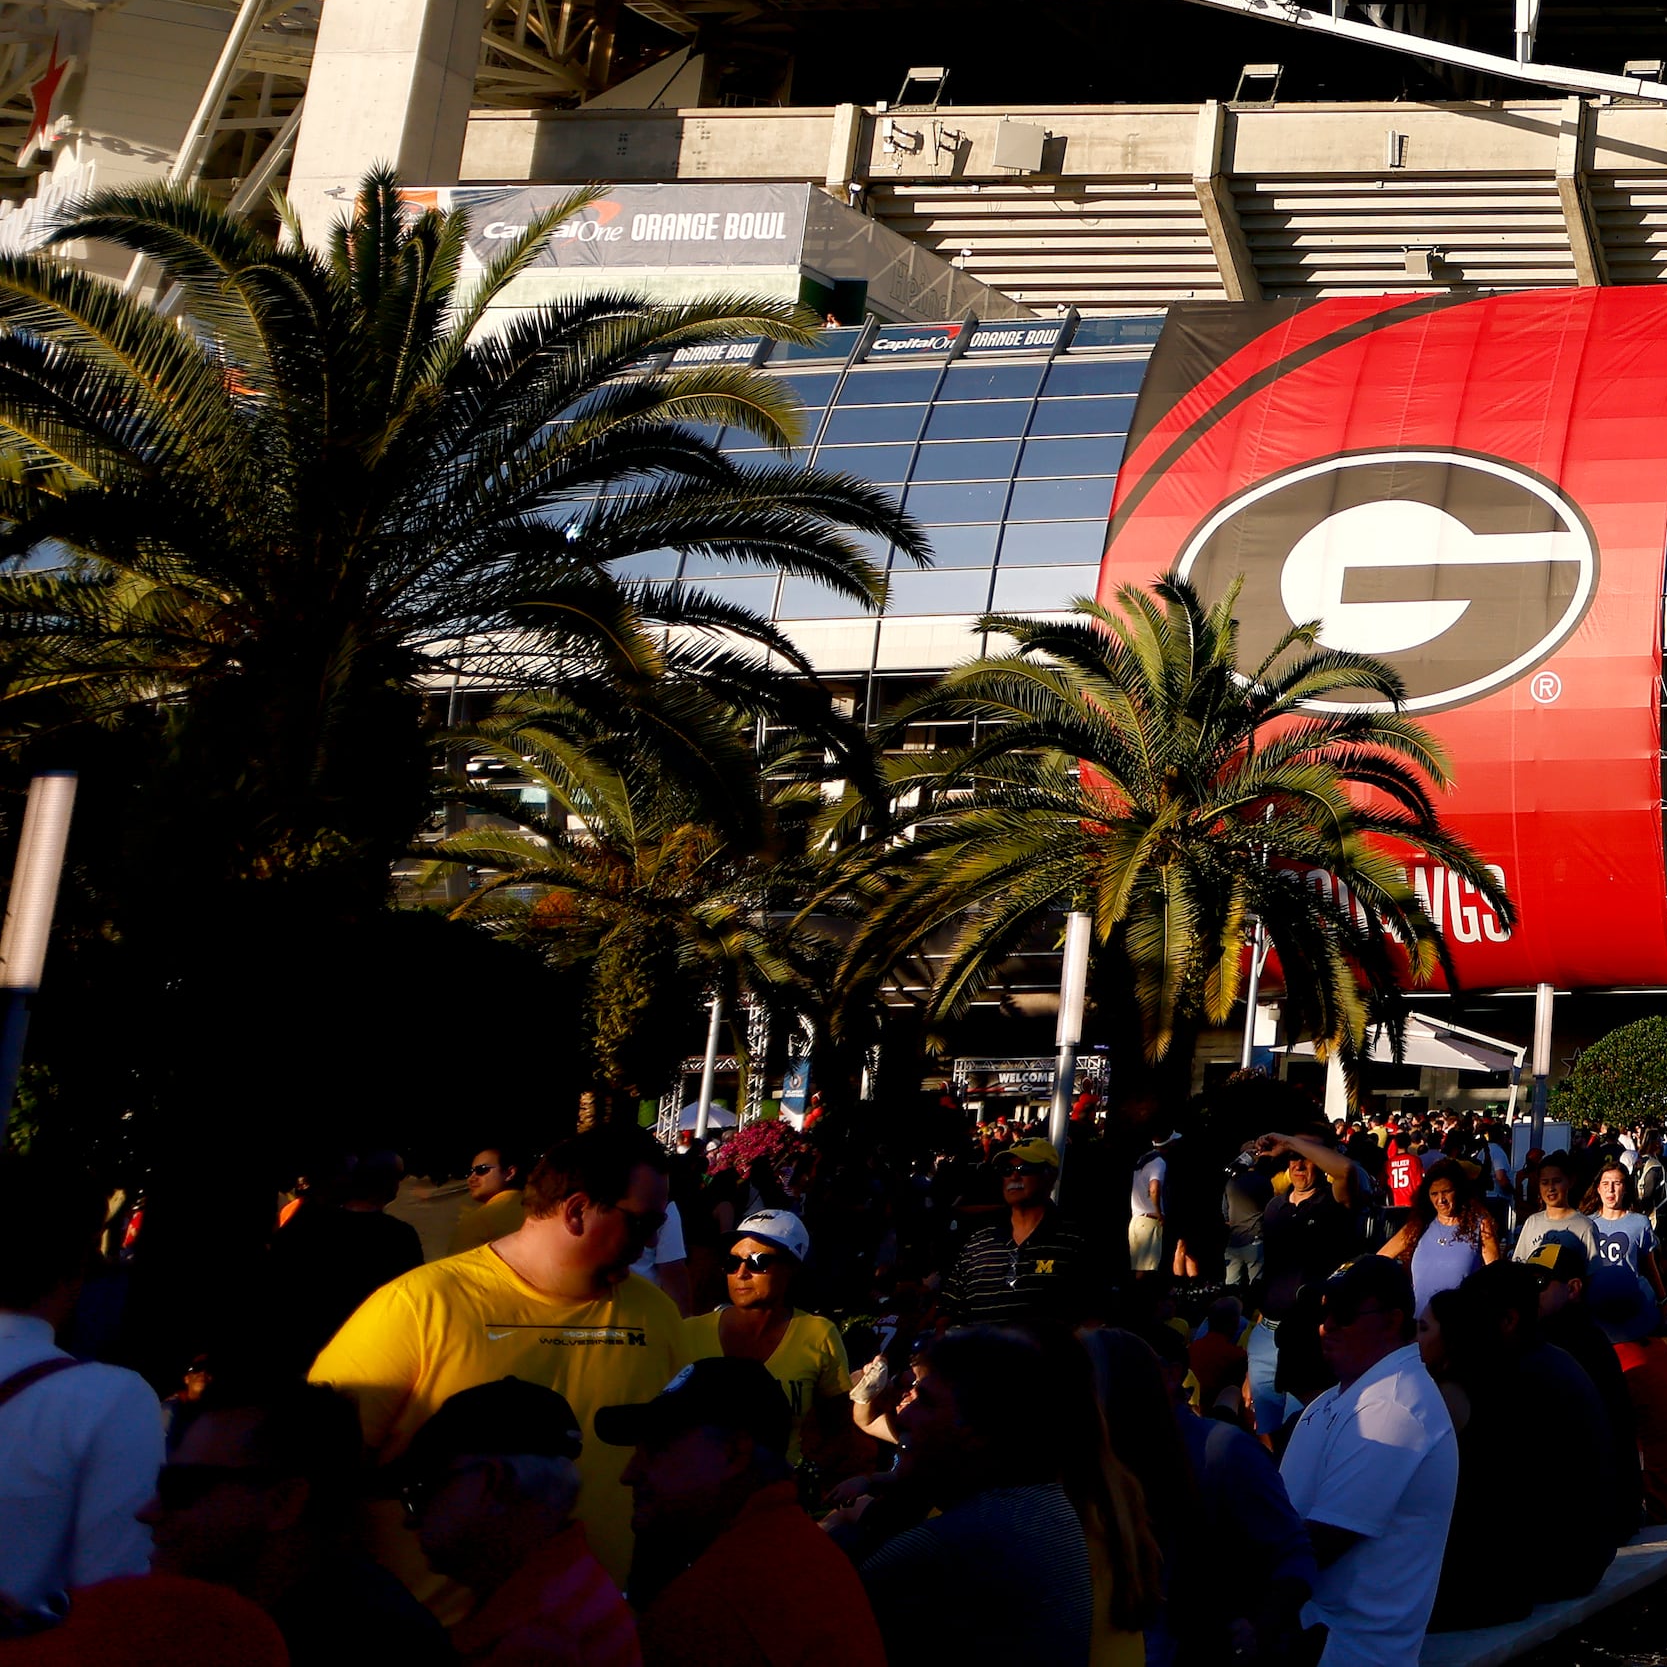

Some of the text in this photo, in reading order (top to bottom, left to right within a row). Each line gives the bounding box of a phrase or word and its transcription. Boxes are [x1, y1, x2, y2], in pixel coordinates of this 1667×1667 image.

[631, 212, 718, 241] ORANGE
[724, 211, 787, 240] BOWL
[969, 330, 1023, 349] ORANGE
[1024, 328, 1060, 346] BOW
[672, 345, 725, 362] ORANGE
[724, 342, 756, 360] BOW
[999, 1072, 1055, 1083] WELCOME
[1391, 1160, 1410, 1169] WALKER
[1391, 1168, 1410, 1188] 15
[1034, 1259, 1055, 1274] M
[627, 1332, 646, 1346] M
